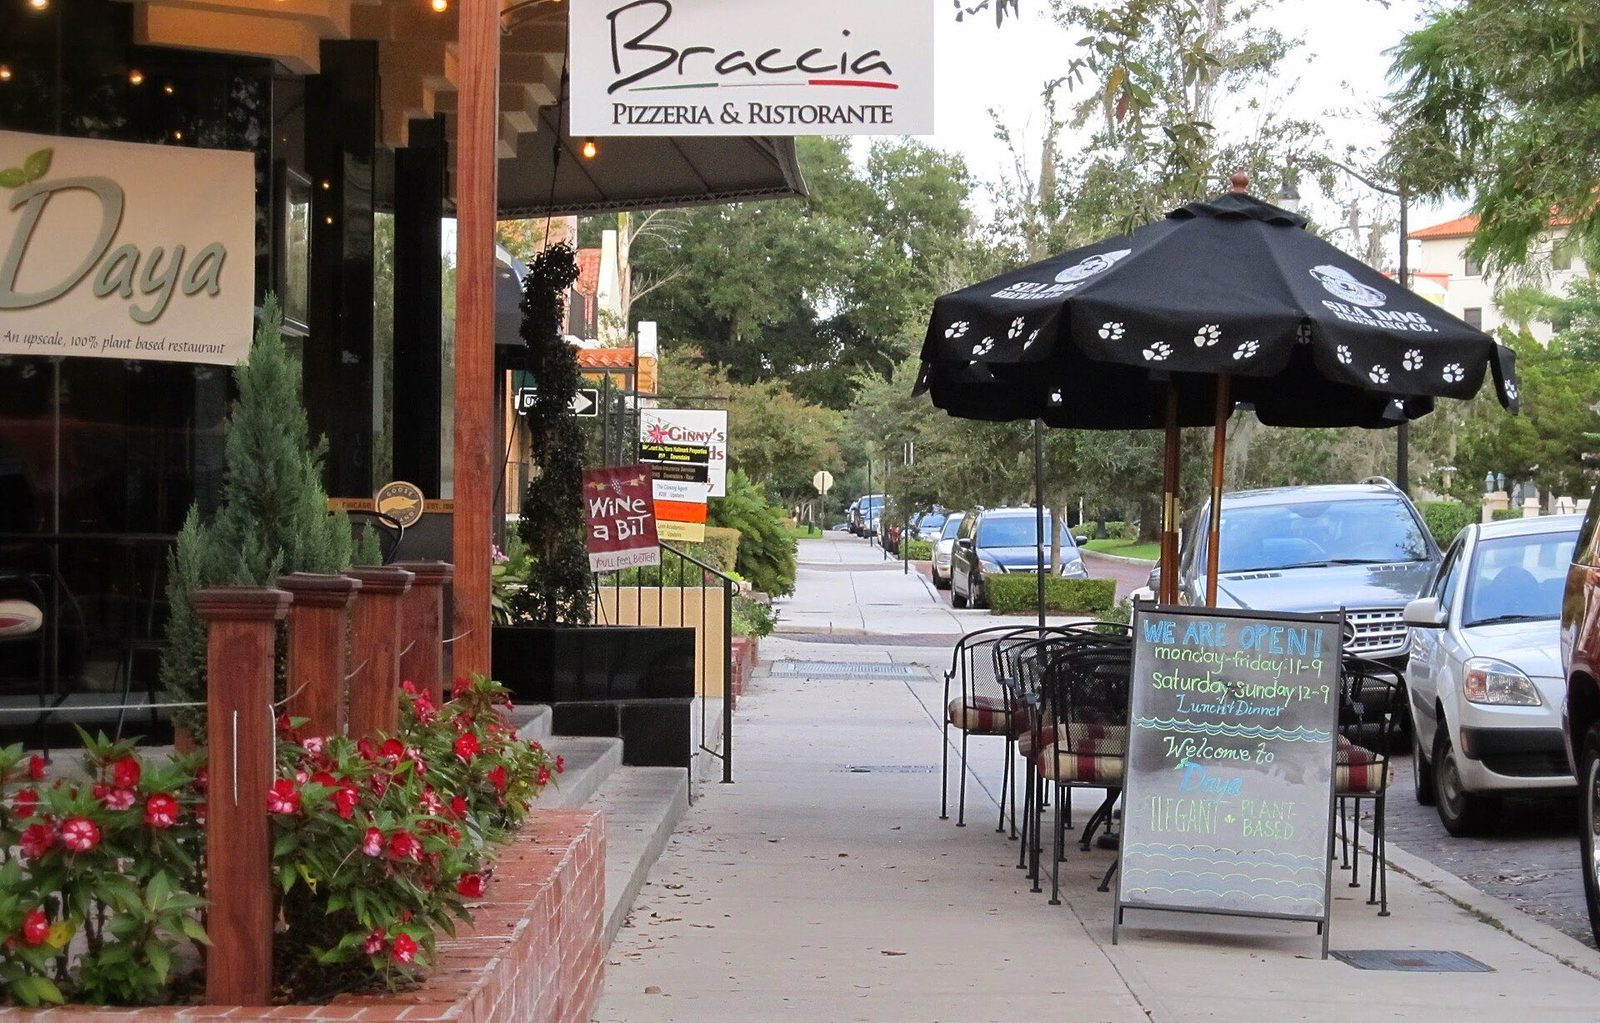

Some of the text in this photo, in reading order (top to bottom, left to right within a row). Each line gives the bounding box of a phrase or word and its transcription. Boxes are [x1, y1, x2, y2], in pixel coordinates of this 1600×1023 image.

[606, 0, 892, 95] Braccia
[612, 103, 893, 125] PIZZERIA & RISTORANTE
[0, 175, 227, 324] Daya
[1322, 300, 1427, 324] SEA DOG
[3, 330, 226, 353] An upscale, 100% plant based restaurant
[386, 487, 414, 497] GOOSE
[1143, 619, 1325, 658] WE ARE OPEN!
[1235, 700, 1286, 717] Dinner
[1163, 736, 1275, 765] Welcome to
[1242, 818, 1295, 840] BASED
